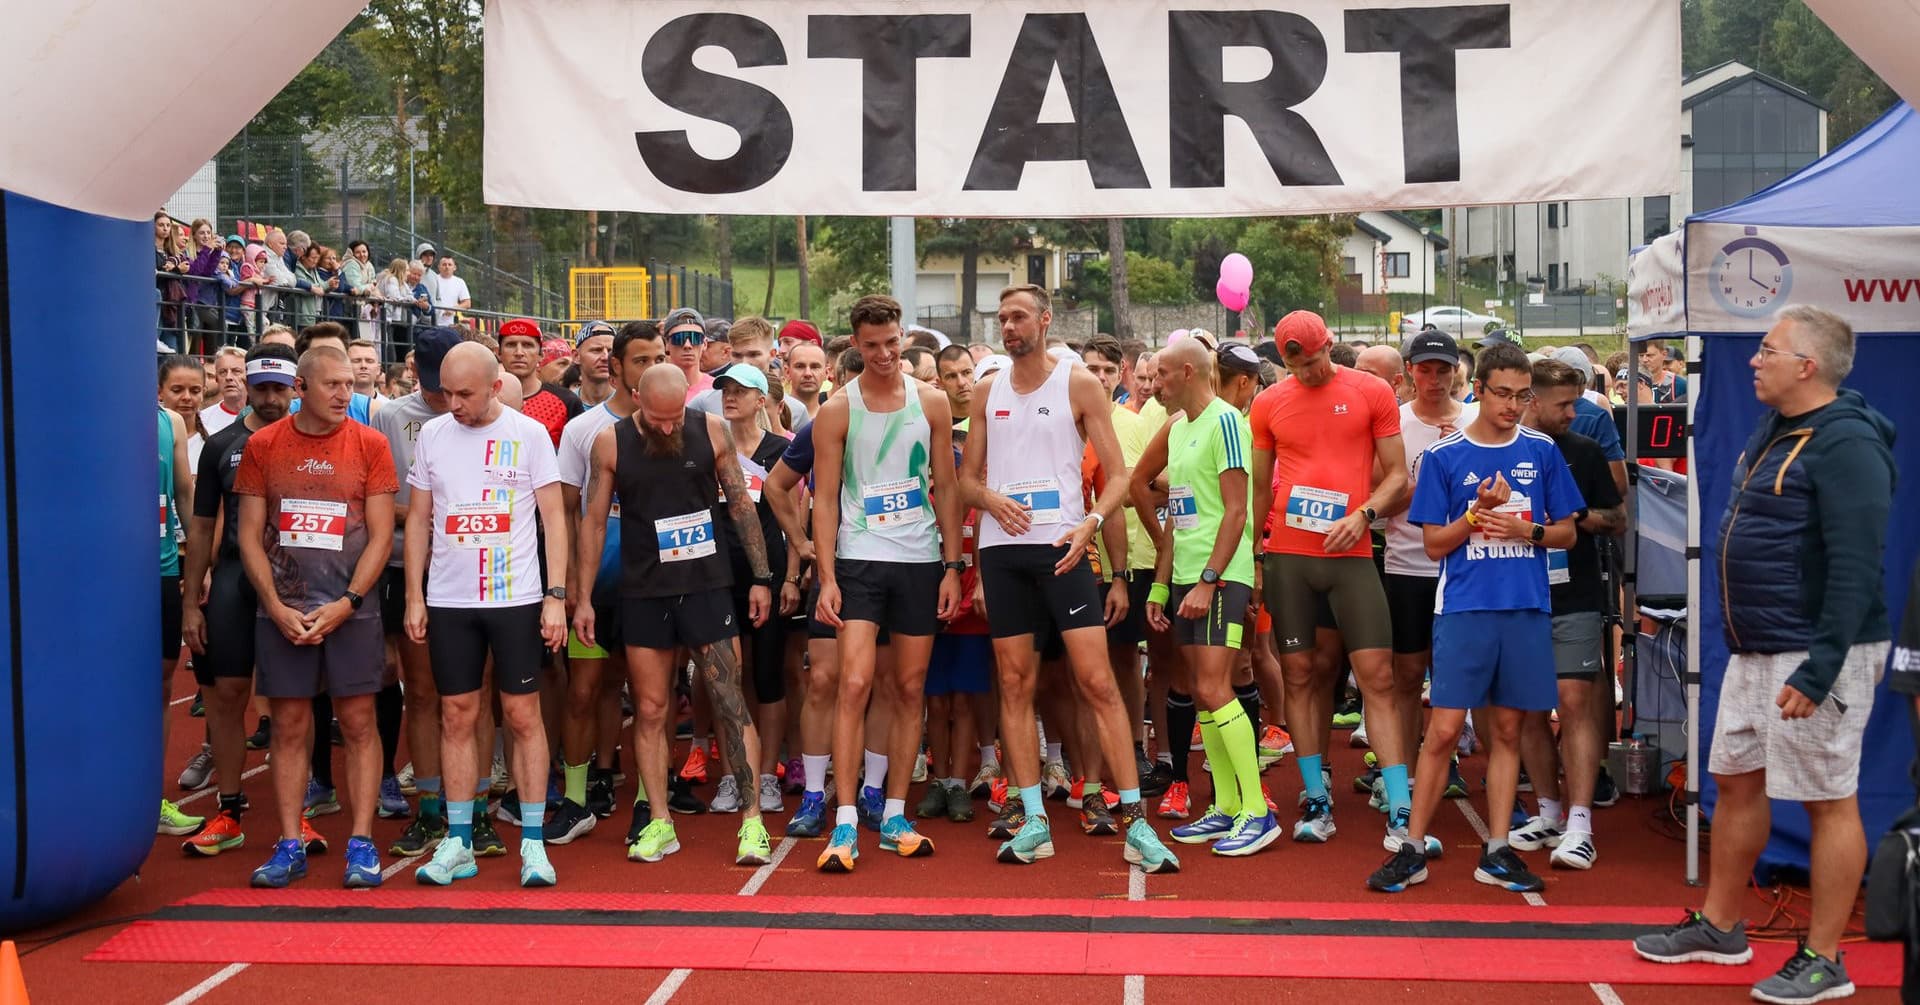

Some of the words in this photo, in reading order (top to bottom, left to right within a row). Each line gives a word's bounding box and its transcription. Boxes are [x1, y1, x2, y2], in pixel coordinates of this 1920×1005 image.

[635, 4, 1511, 195] START
[485, 440, 521, 466] FIAT
[296, 459, 335, 474] Aloha
[1511, 469, 1538, 478] OWENT
[883, 494, 908, 511] 58
[1299, 500, 1334, 519] 101
[290, 513, 334, 532] 257
[456, 515, 498, 532] 263
[671, 526, 706, 546] 173
[480, 547, 512, 574] FIAT
[480, 575, 512, 601] FIAT
